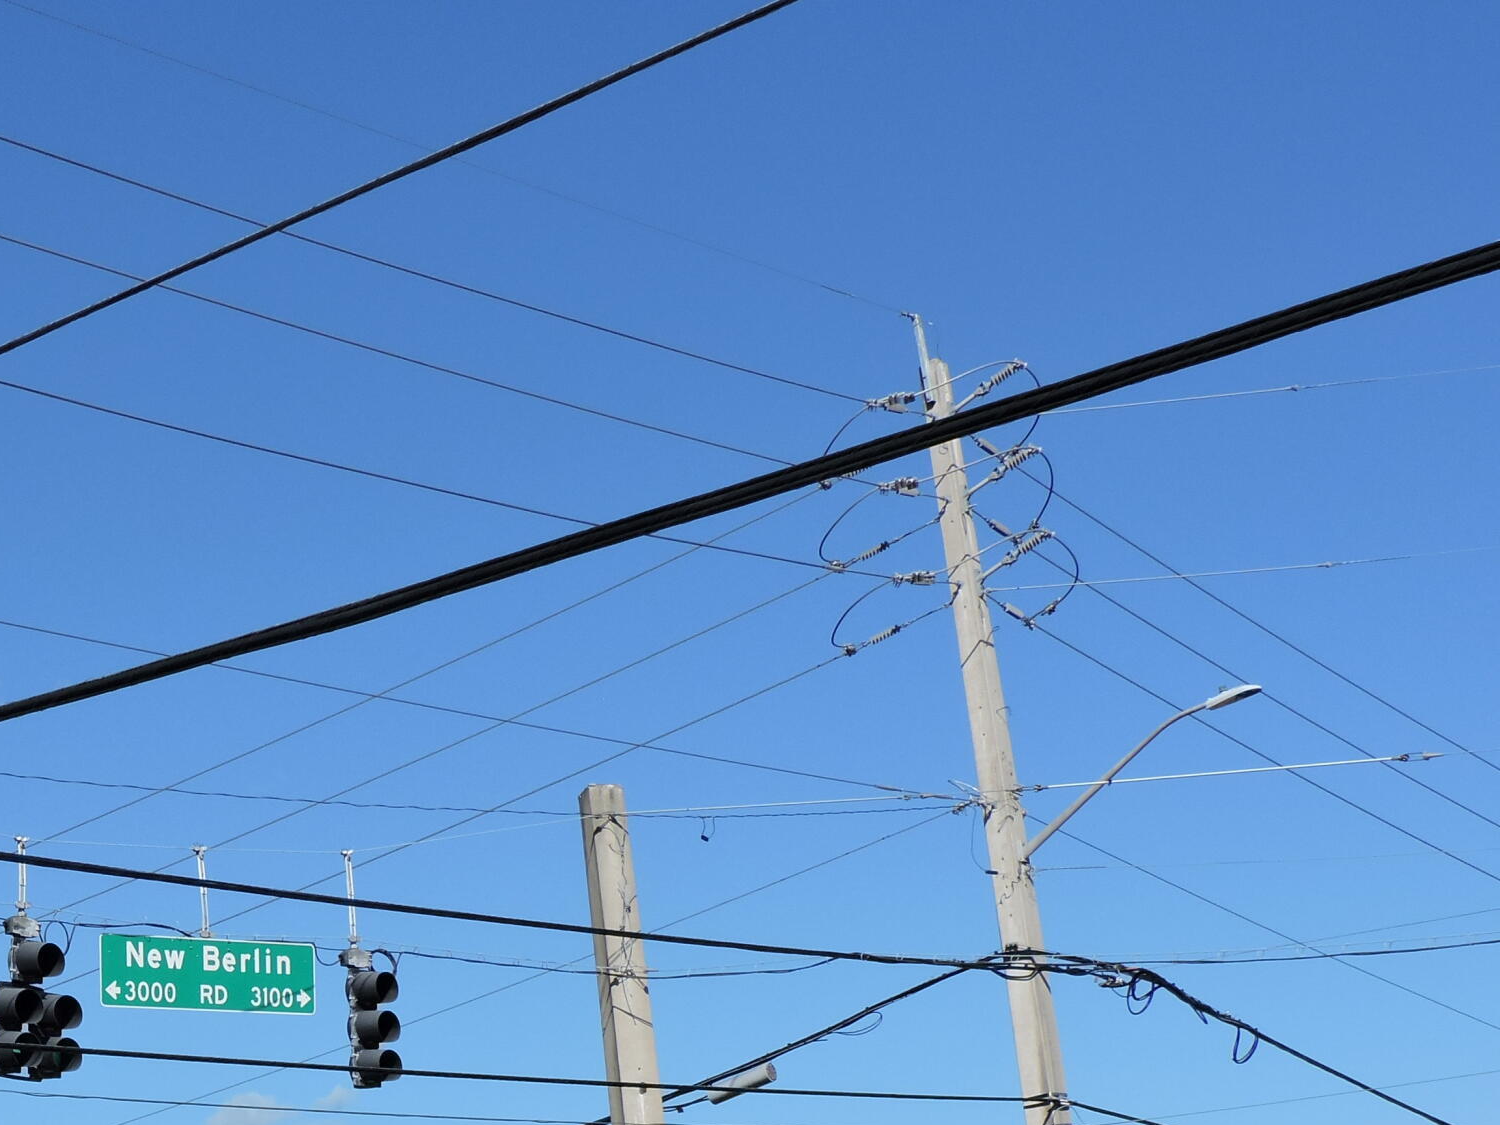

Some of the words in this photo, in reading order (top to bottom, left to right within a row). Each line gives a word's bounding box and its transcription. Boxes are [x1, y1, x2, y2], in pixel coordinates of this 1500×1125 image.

[126, 941, 185, 970] New
[203, 945, 291, 975] Berlin
[125, 981, 176, 1003] 3000
[200, 984, 229, 1005] RD
[250, 986, 294, 1008] 3100
